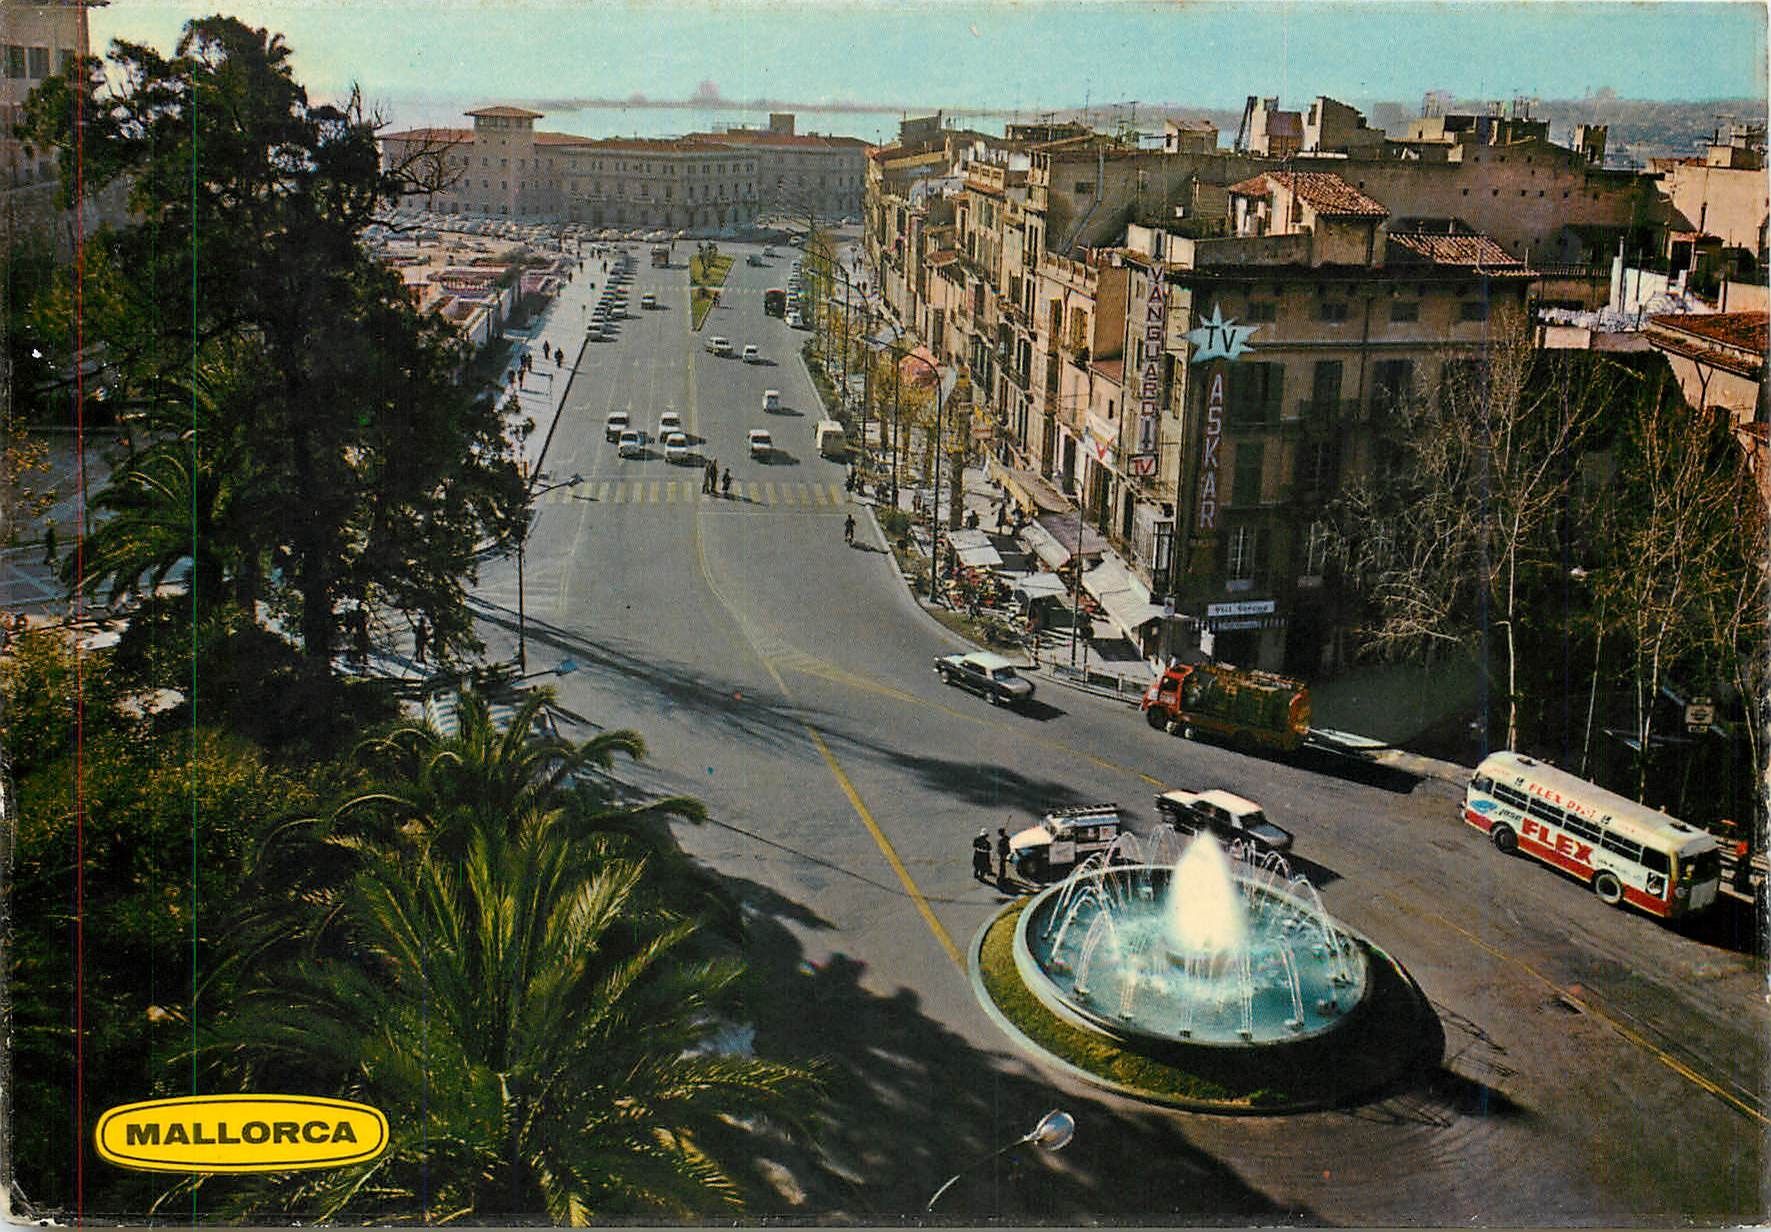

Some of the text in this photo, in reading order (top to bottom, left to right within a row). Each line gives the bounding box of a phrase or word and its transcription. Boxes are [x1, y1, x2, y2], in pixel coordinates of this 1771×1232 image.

[1141, 266, 1164, 417] VANGUARD
[1204, 325, 1237, 353] TV
[1132, 458, 1154, 475] TV
[1200, 373, 1224, 529] ASKAR
[1528, 783, 1562, 805] FLEX
[1522, 817, 1594, 864] FLEX
